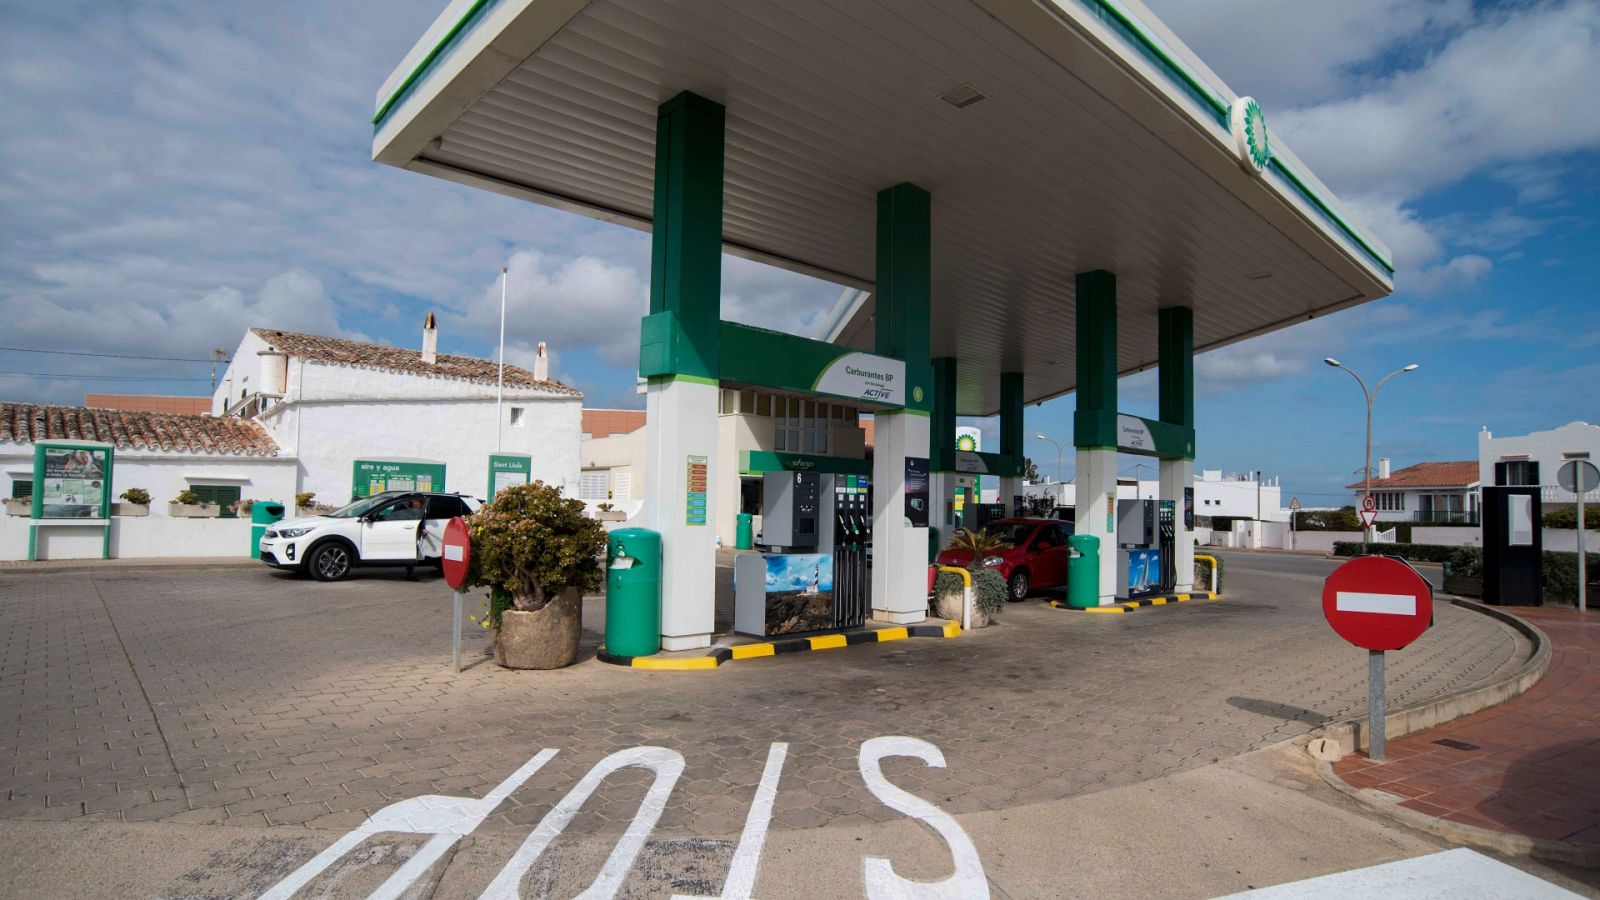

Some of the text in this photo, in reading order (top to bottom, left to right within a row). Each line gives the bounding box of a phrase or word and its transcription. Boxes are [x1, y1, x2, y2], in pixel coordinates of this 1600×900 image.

[845, 366, 894, 383] Carburantes BP
[863, 389, 891, 399] ACTIVE
[382, 465, 400, 473] agua
[797, 473, 802, 484] 6
[257, 736, 989, 900] STOP
